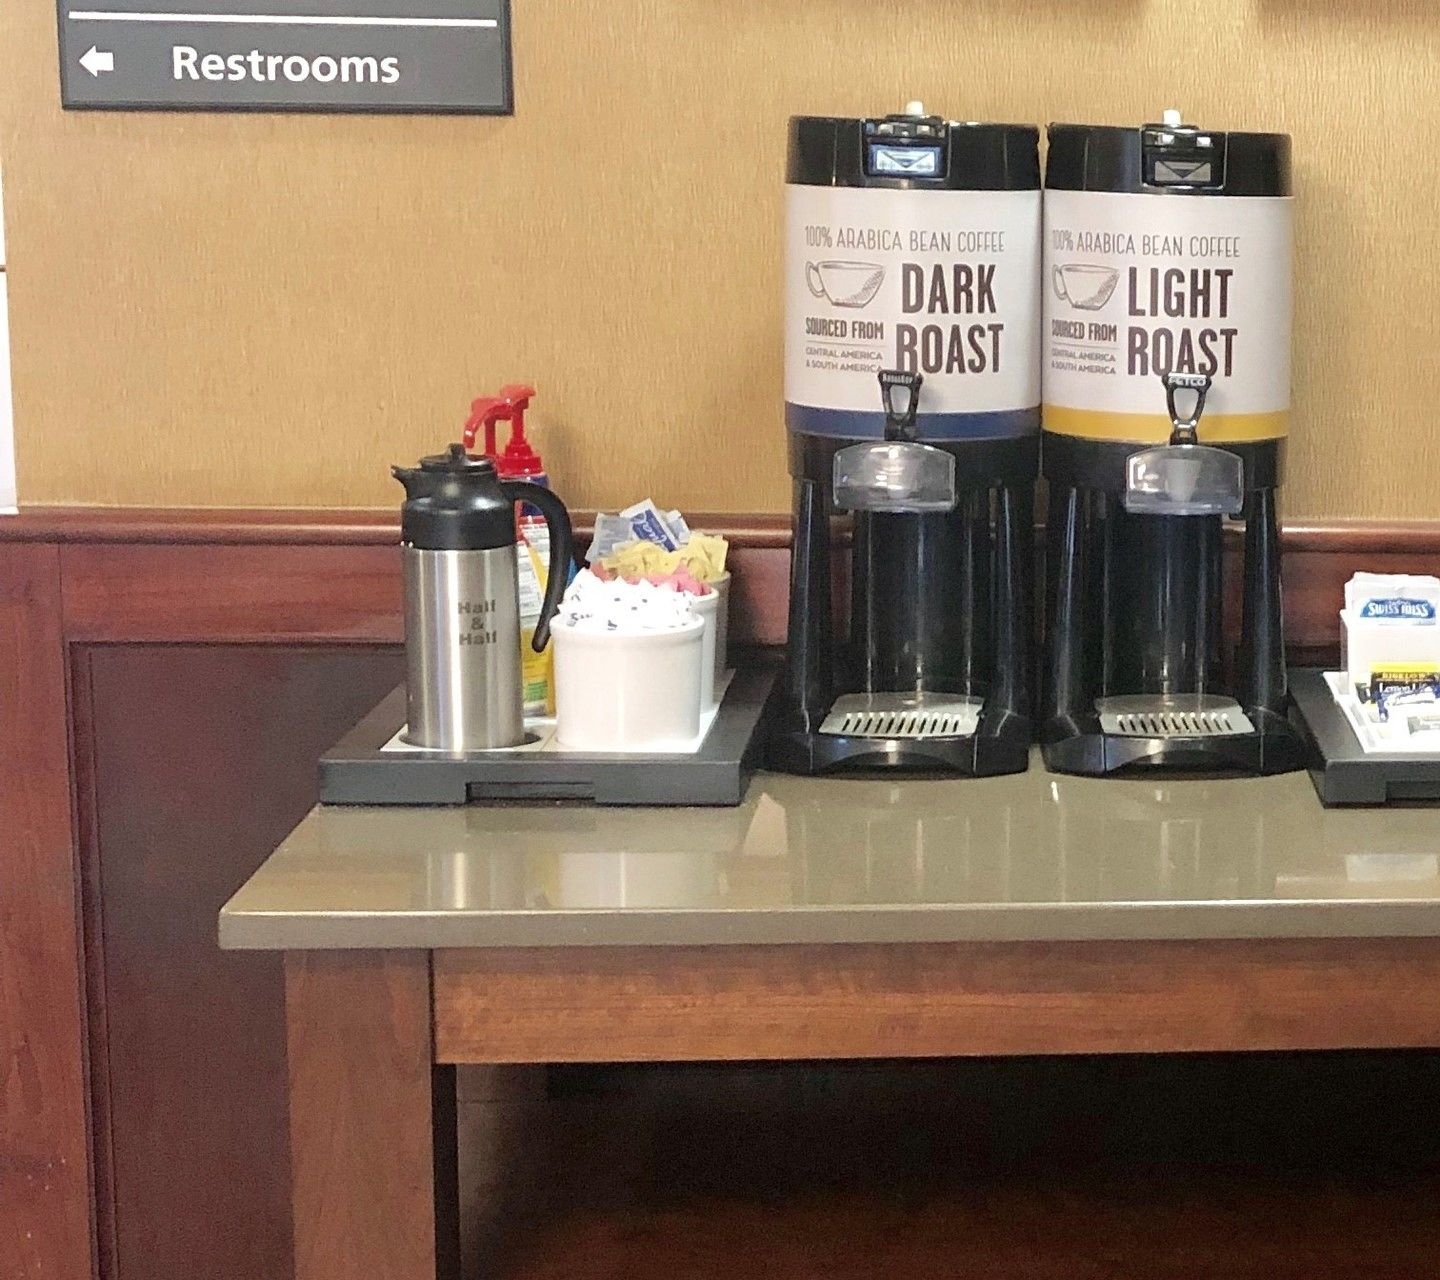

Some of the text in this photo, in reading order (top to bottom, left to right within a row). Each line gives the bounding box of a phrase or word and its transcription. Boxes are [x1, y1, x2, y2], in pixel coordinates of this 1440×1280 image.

[172, 45, 400, 84] Restrooms
[805, 225, 1005, 253] 100% ARABICA BEAN COFFEE
[1076, 232, 1136, 255] ARABICA
[1142, 235, 1183, 257] BEAN
[1190, 236, 1241, 258] COFFEE
[902, 262, 996, 314] DARK
[1128, 266, 1234, 318] LIGHT
[805, 317, 884, 340] SOURCED FROM
[1088, 323, 1117, 342] FROM
[840, 350, 883, 360] AMERICA
[896, 323, 1004, 374] ROAST
[1127, 326, 1238, 377] ROAST
[812, 360, 838, 370] SOUTH
[840, 363, 883, 373] AMERICA
[458, 599, 497, 614] Half
[471, 617, 485, 630] &
[459, 630, 497, 646] Half
